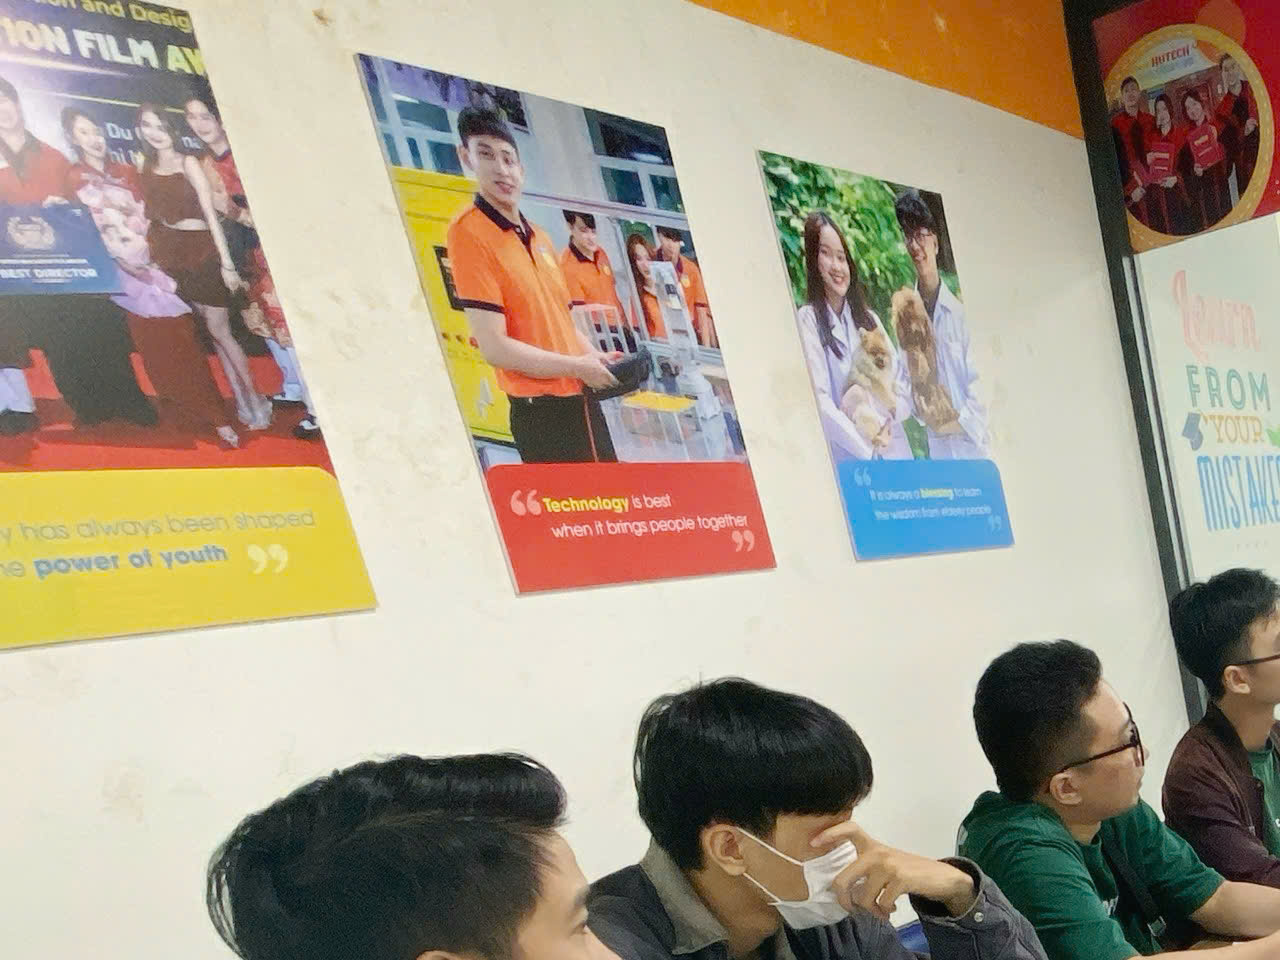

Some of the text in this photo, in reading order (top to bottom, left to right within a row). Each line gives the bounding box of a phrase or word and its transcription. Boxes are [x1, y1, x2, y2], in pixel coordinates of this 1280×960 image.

[0, 16, 72, 55] ION
[72, 29, 159, 69] FILM
[32, 268, 98, 279] DIRECTOR
[1185, 364, 1271, 412] FROM
[1208, 414, 1265, 444] YOUR
[543, 493, 672, 513] Technology is best
[19, 521, 70, 540] has
[77, 517, 161, 539] always
[167, 513, 230, 533] been
[235, 508, 315, 531] shaped
[551, 513, 748, 538] when it brings people together
[34, 553, 119, 580] power
[129, 547, 153, 568] of
[160, 543, 228, 569] youth
